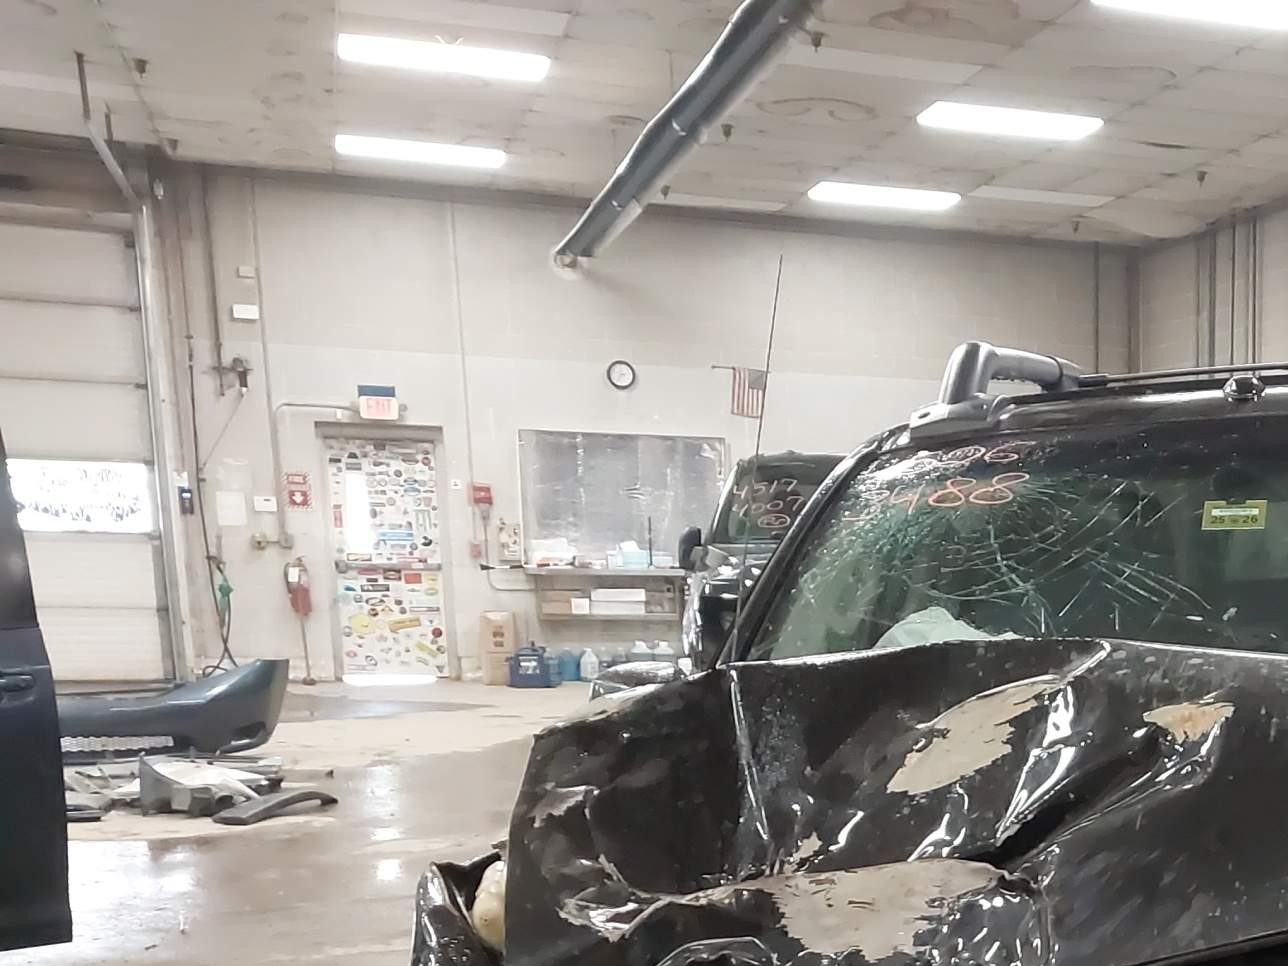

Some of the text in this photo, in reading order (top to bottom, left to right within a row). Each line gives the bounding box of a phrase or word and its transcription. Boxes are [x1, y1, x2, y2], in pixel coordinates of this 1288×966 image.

[733, 478, 798, 500] 4517
[731, 495, 805, 518] 4007
[1209, 514, 1259, 524] 25 26
